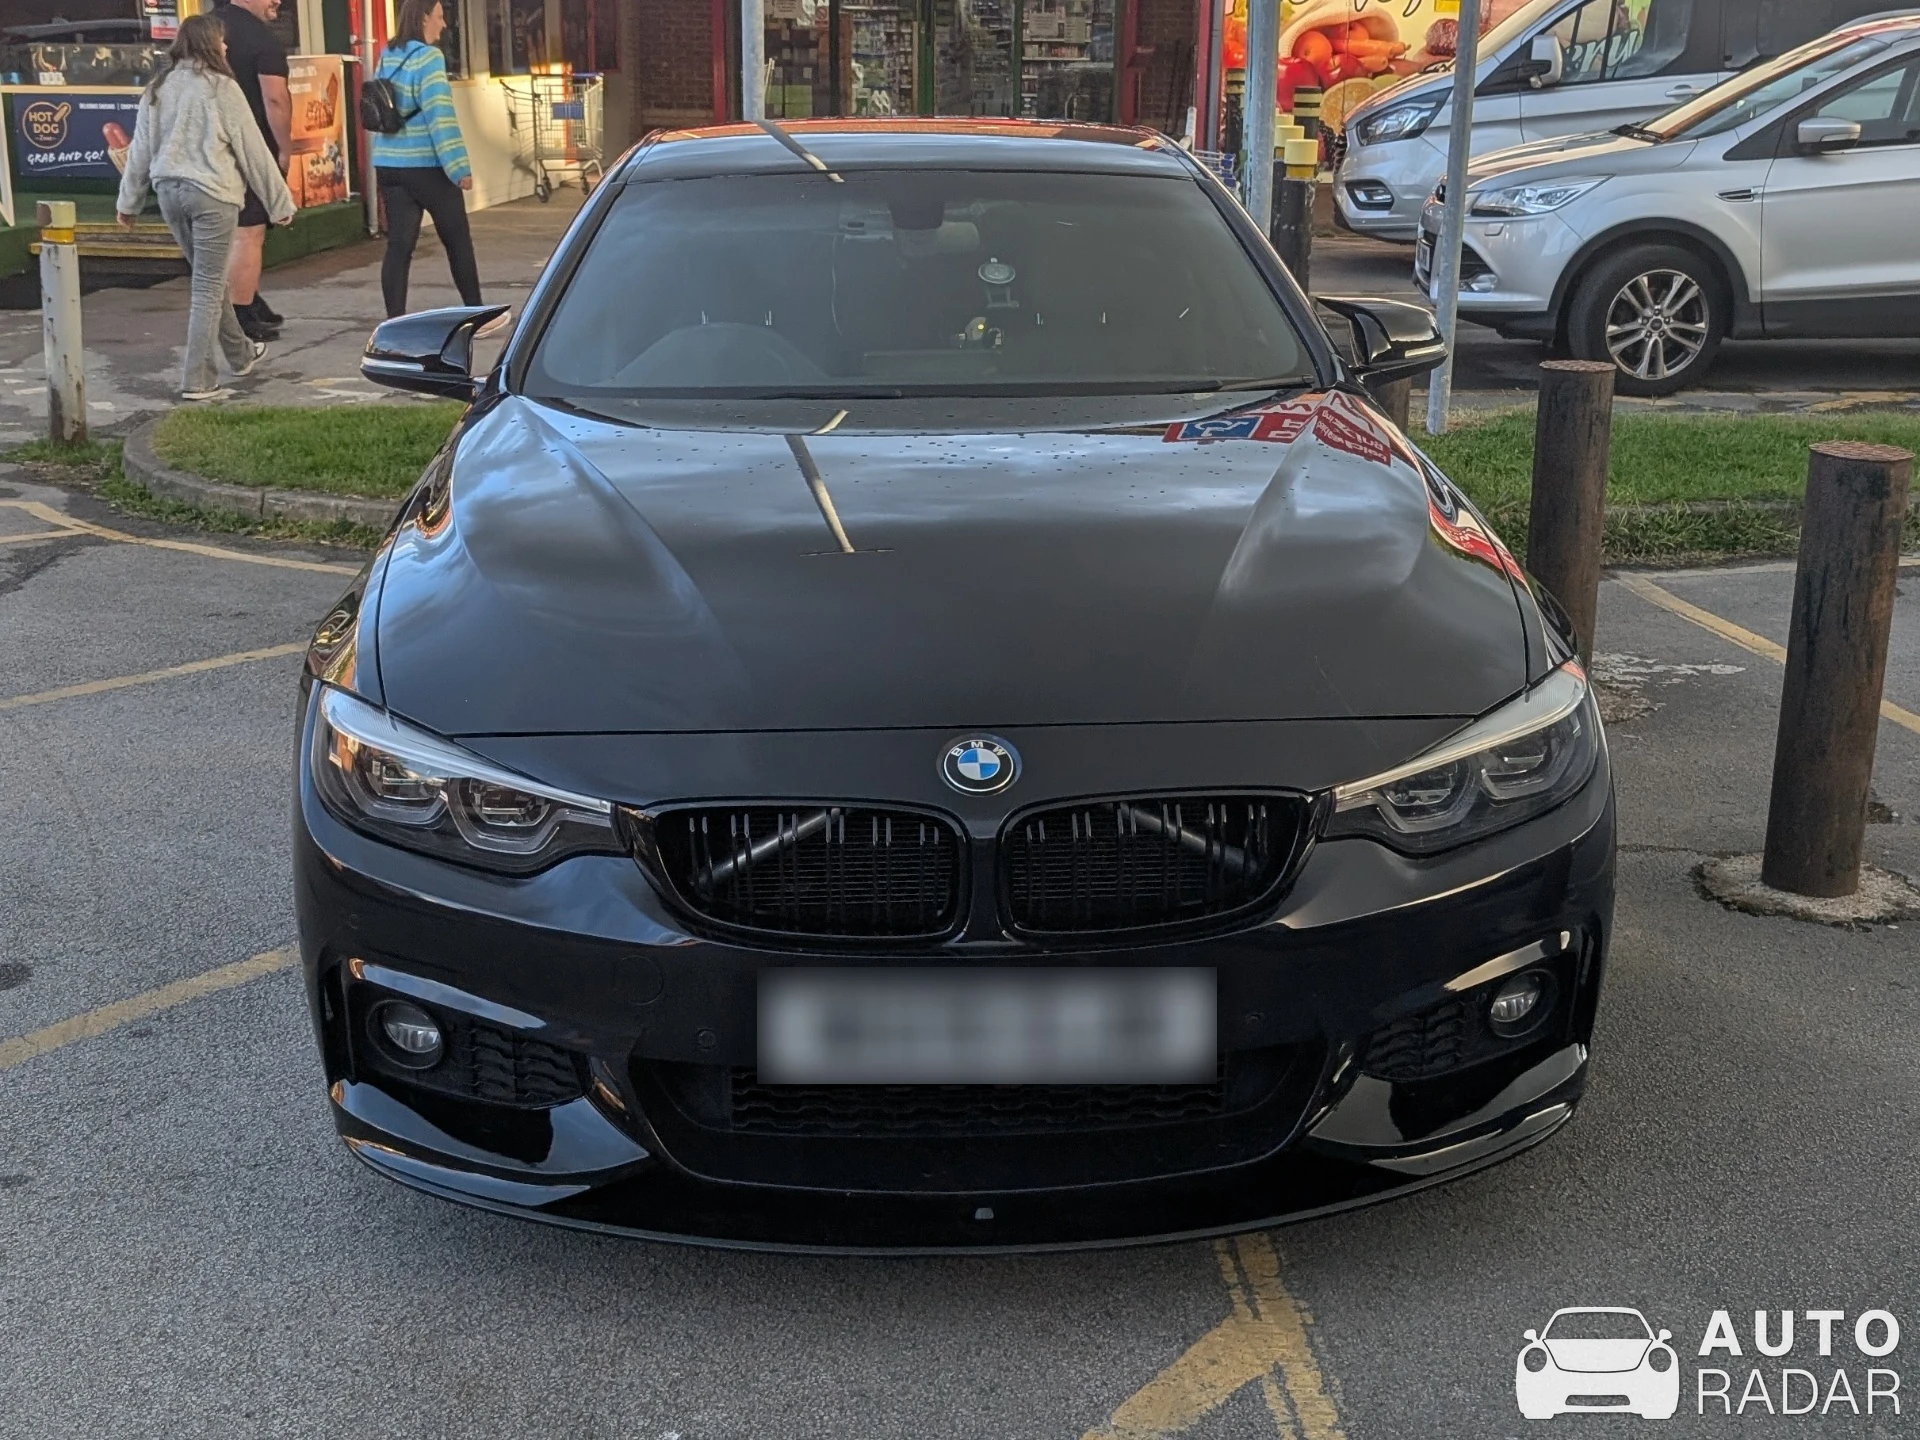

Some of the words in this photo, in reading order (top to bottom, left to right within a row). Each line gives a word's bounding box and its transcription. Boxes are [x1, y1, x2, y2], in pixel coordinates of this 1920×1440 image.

[28, 111, 53, 122] HOT
[33, 123, 60, 134] DOG
[26, 152, 56, 165] GRAB
[58, 150, 82, 162] AND
[84, 149, 104, 163] GO!
[950, 741, 1007, 757] BMW
